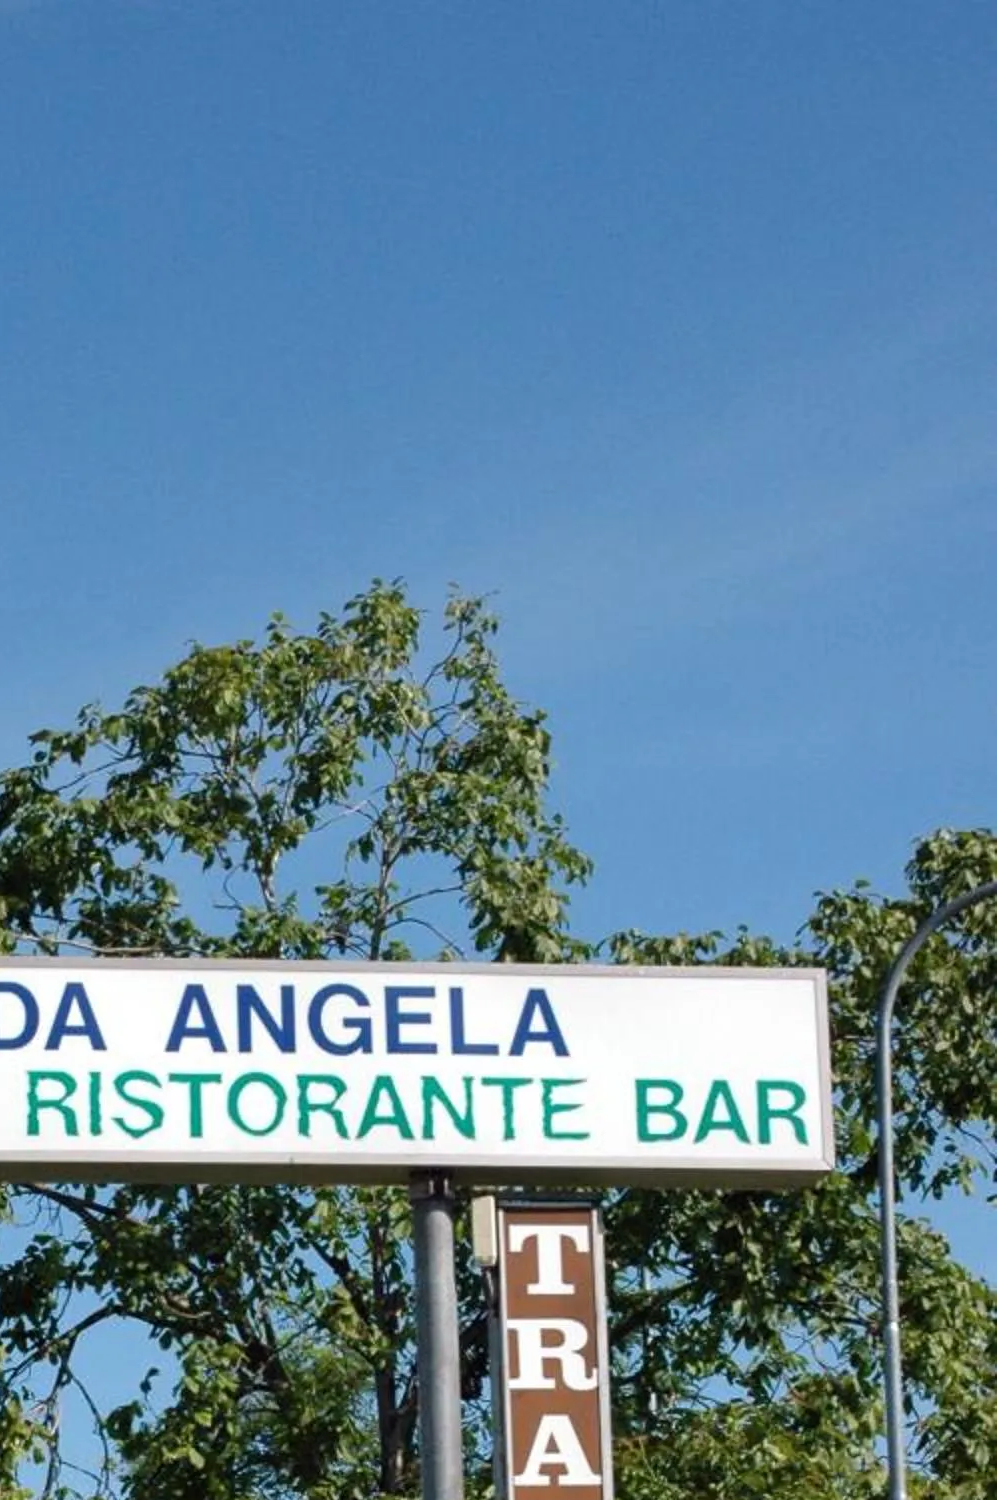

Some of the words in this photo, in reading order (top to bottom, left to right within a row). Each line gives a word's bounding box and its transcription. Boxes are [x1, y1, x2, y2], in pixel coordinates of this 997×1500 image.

[164, 982, 571, 1057] ANGELA
[26, 1069, 590, 1141] RISTORANTE
[634, 1077, 810, 1147] BAR
